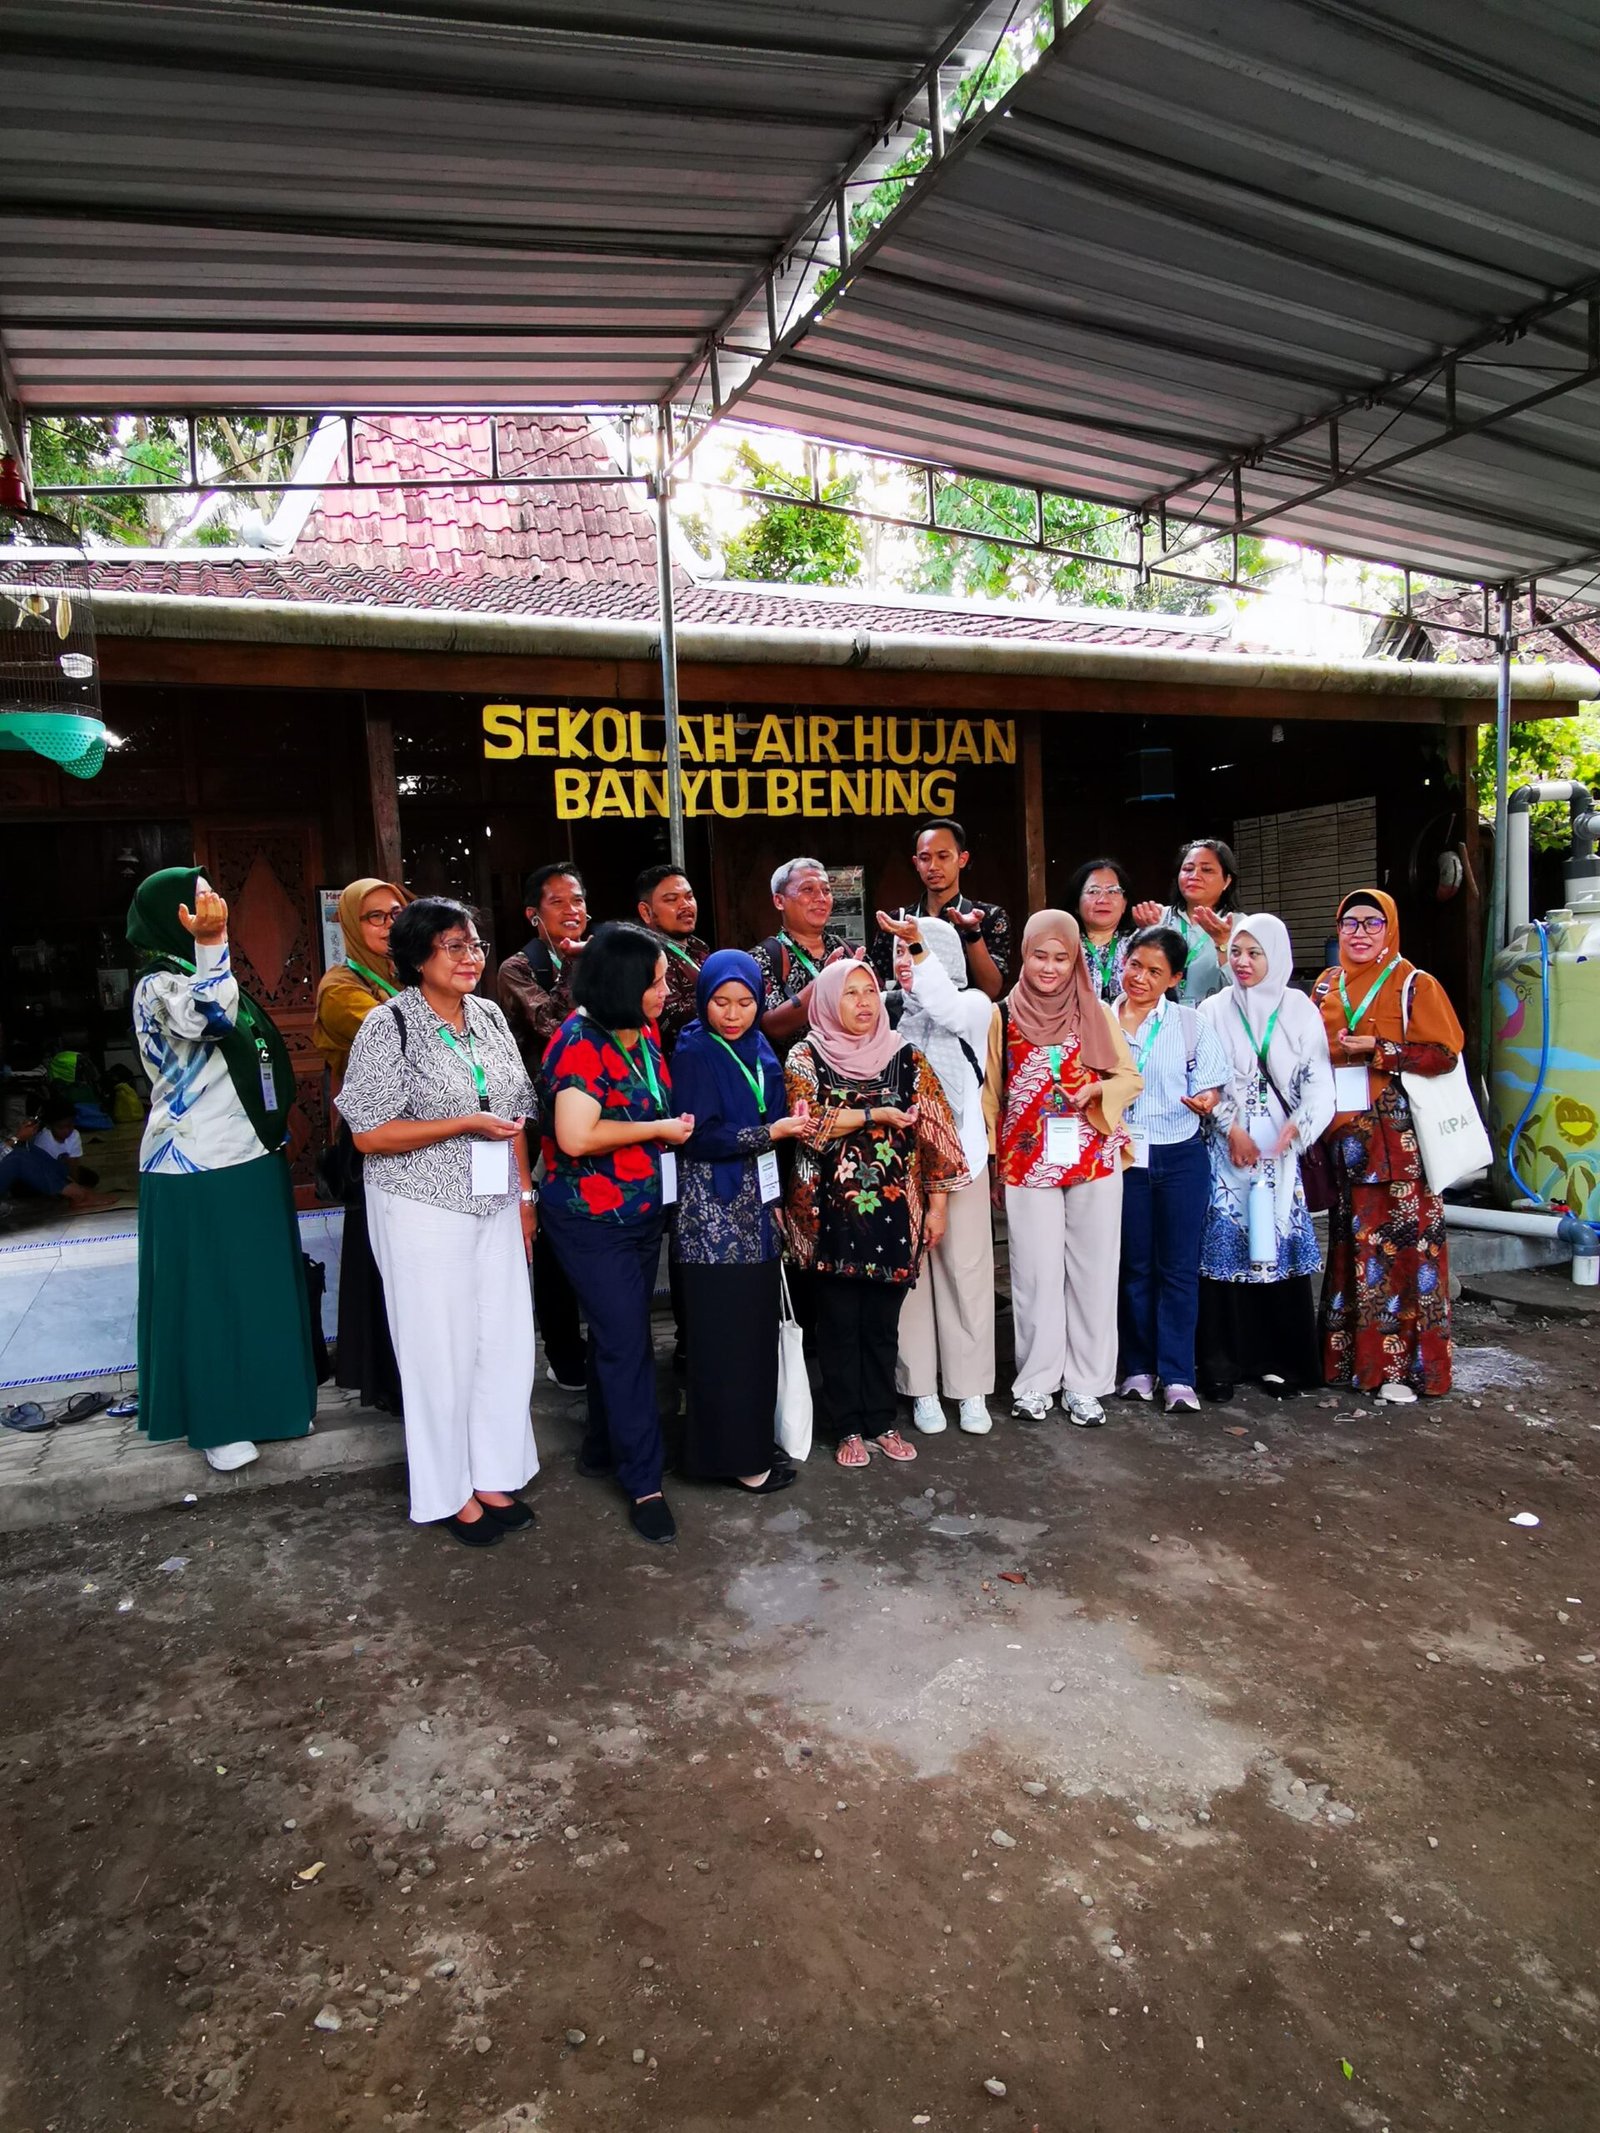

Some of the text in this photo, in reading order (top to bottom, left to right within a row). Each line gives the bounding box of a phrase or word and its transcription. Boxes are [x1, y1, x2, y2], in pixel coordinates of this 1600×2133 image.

[483, 704, 1017, 765] SEKOLAH AIR HUJAN
[554, 767, 957, 819] BANYU BENING
